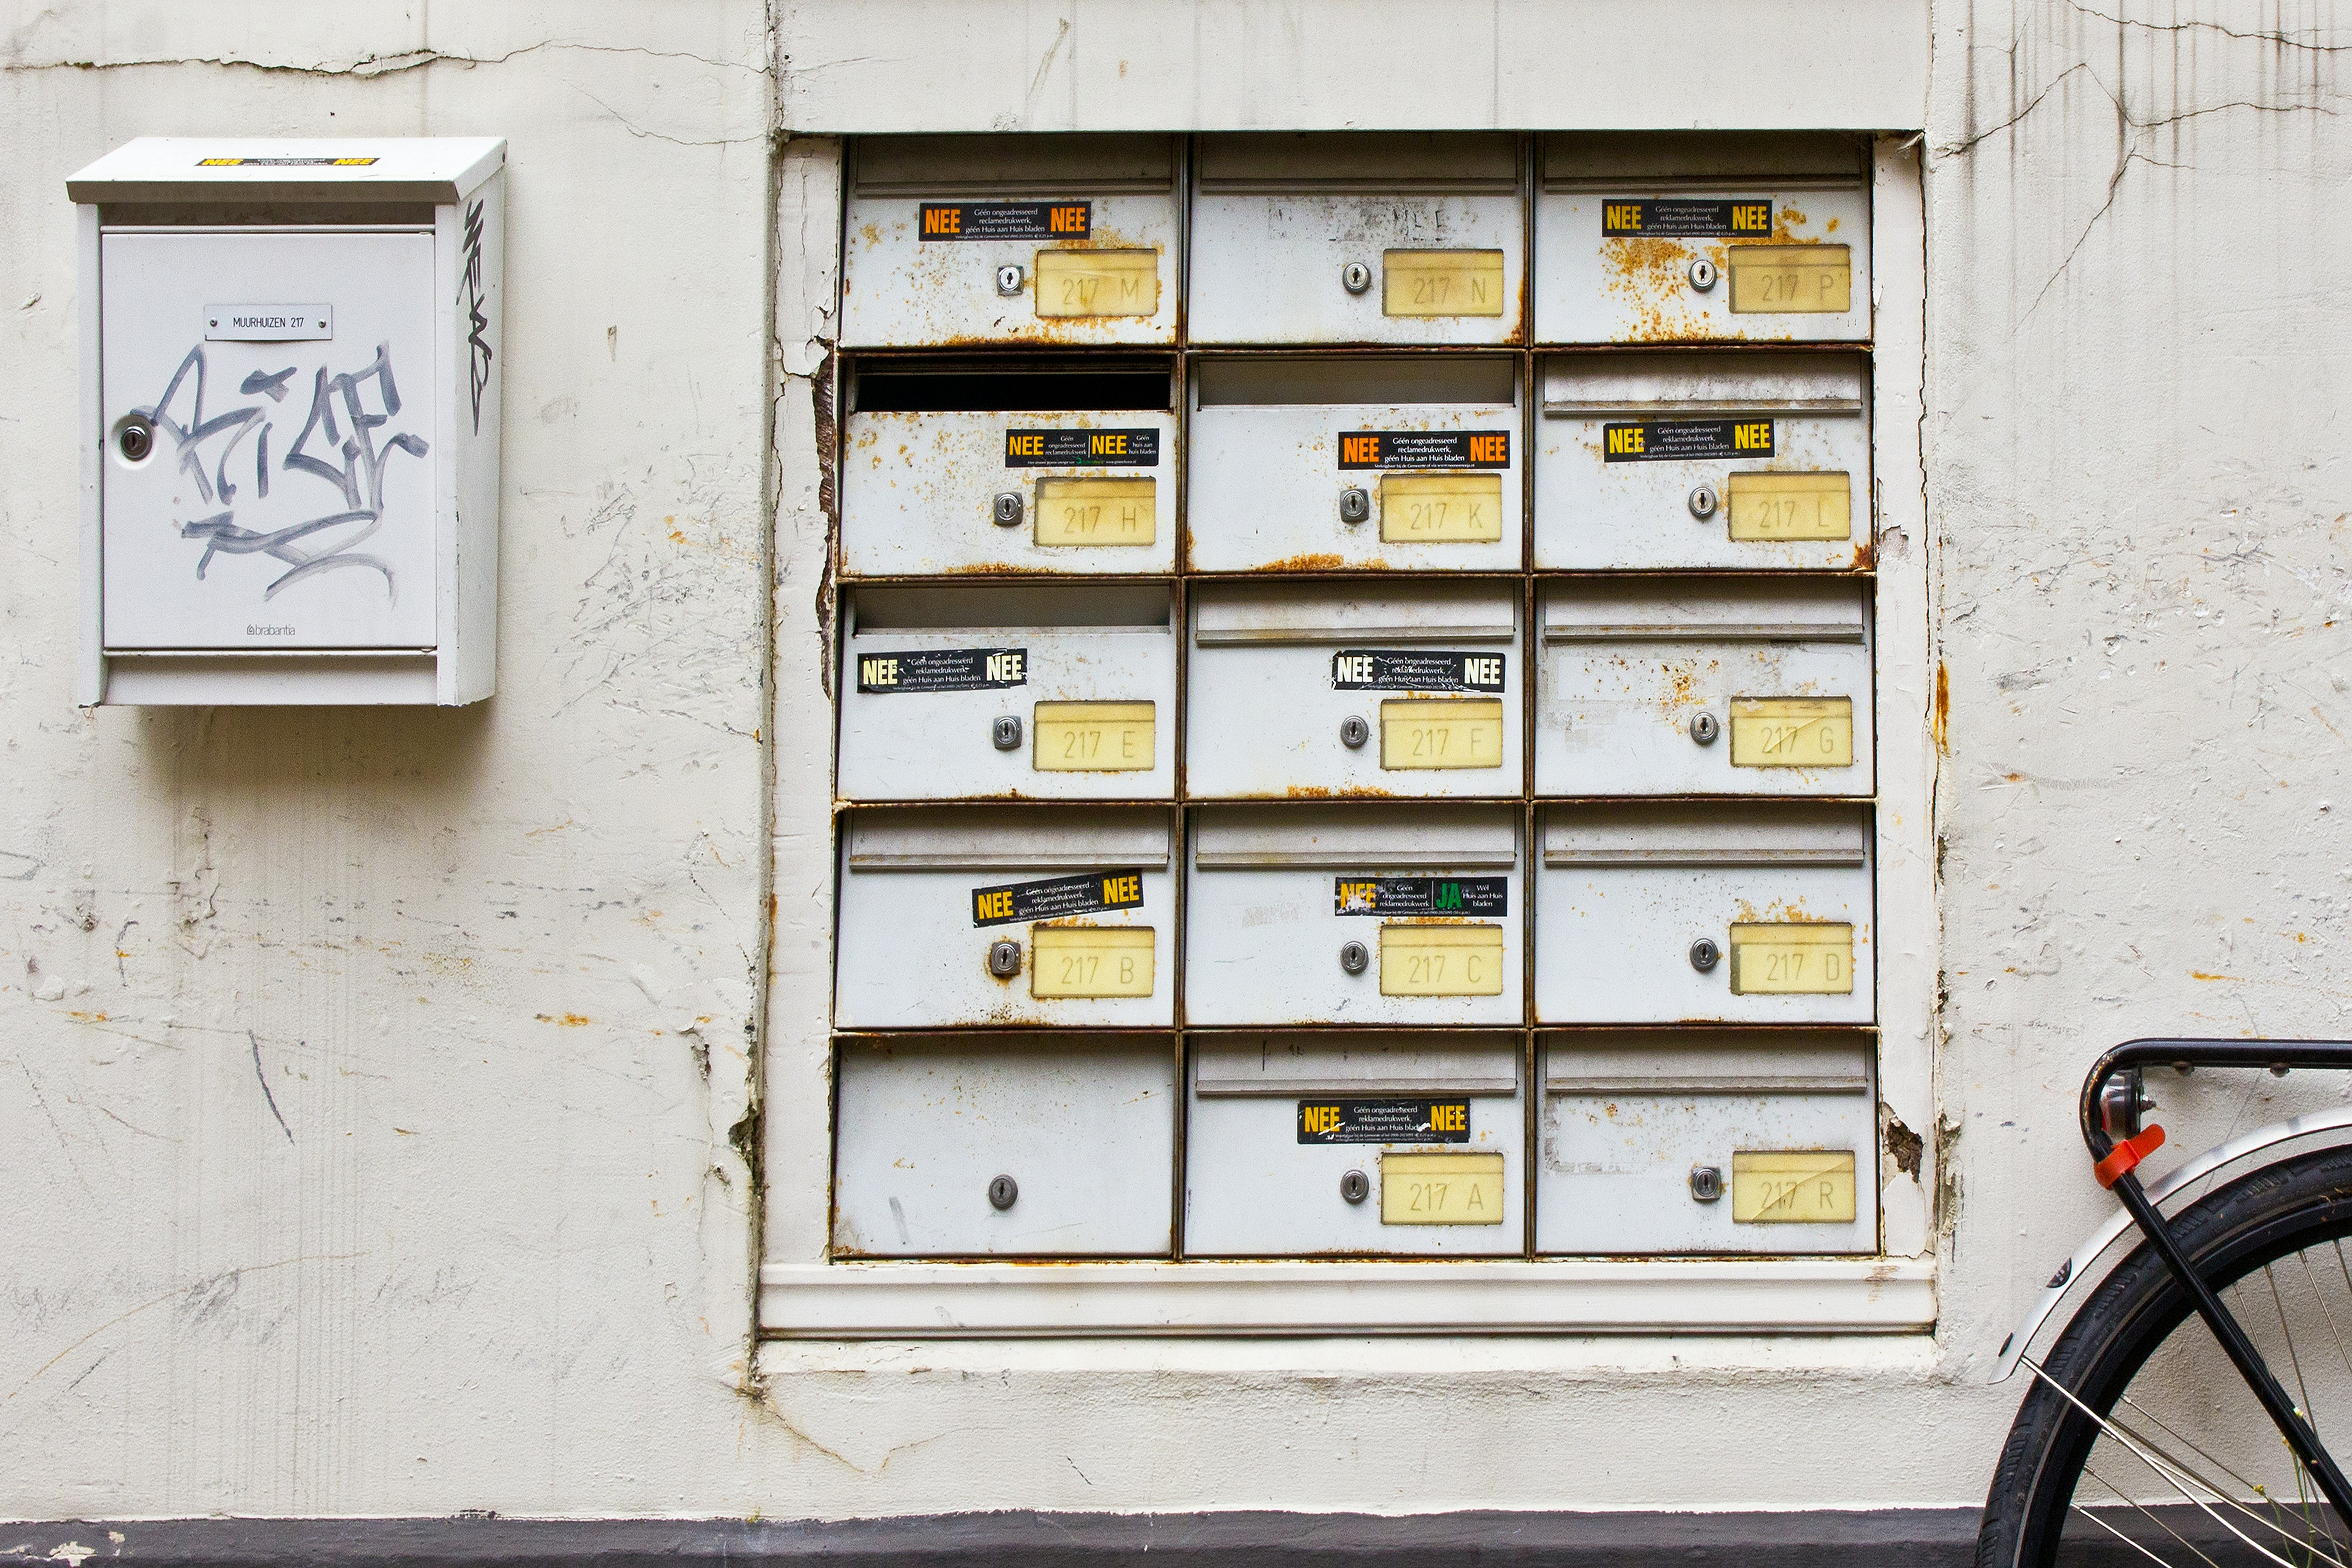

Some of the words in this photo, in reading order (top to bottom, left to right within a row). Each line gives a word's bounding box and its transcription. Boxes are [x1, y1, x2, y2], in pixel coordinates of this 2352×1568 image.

[925, 209, 960, 233] NEE
[992, 208, 1038, 216] ongeadresseerd
[1050, 207, 1085, 232] NEE
[1607, 206, 1641, 229] NEE
[1673, 206, 1718, 215] ongeadresseerd
[1732, 206, 1767, 230] NEE
[1063, 278, 1099, 305] 217
[1121, 278, 1139, 302] M
[1414, 277, 1450, 304] 217
[1472, 278, 1485, 303] N
[1762, 274, 1798, 301] 217
[1820, 274, 1834, 301] P
[233, 317, 285, 327] MUURHUIZEN
[291, 317, 304, 327] 217
[1411, 437, 1457, 446] ongeadresseerd
[1609, 428, 1644, 453] NEE
[1675, 426, 1721, 434] ongeadresseerd
[1735, 424, 1770, 449] NEE
[1009, 436, 1043, 455] NEE
[1092, 435, 1127, 454] NEE
[1344, 437, 1379, 462] NEE
[1470, 437, 1505, 462] NEE
[1064, 506, 1101, 533] 217
[1122, 506, 1136, 532] H
[1411, 503, 1447, 530] 217
[1469, 504, 1482, 528] K
[1759, 501, 1795, 527] 217
[1817, 501, 1829, 527] L
[256, 624, 295, 635] brabantia
[863, 659, 898, 684] NEE
[929, 657, 973, 665] ongeadresseerd
[986, 655, 1022, 680] NEE
[1338, 657, 1373, 682] NEE
[1405, 658, 1451, 666] ongeadresseerd
[1465, 658, 1500, 684] NEE
[1064, 732, 1100, 758] 217
[1123, 731, 1134, 757] E
[1412, 729, 1448, 756] 217
[1471, 728, 1483, 754] F
[1761, 727, 1797, 753] 217
[1820, 727, 1834, 753] G
[1103, 876, 1139, 904] NEE
[1436, 883, 1462, 908] JA
[978, 891, 1014, 919] NEE
[1062, 956, 1098, 983] 217
[1121, 957, 1133, 983] B
[1409, 955, 1445, 983] 217
[1468, 955, 1481, 983] C
[1767, 954, 1803, 980] 217
[1826, 954, 1840, 981] D
[1304, 1107, 1340, 1133] NEE
[1372, 1106, 1417, 1115] ongeadresseerd
[1431, 1105, 1466, 1131] NEE
[1410, 1183, 1447, 1210] 217
[1468, 1183, 1483, 1210] A
[1761, 1181, 1797, 1209] 217
[1820, 1181, 1833, 1209] R
